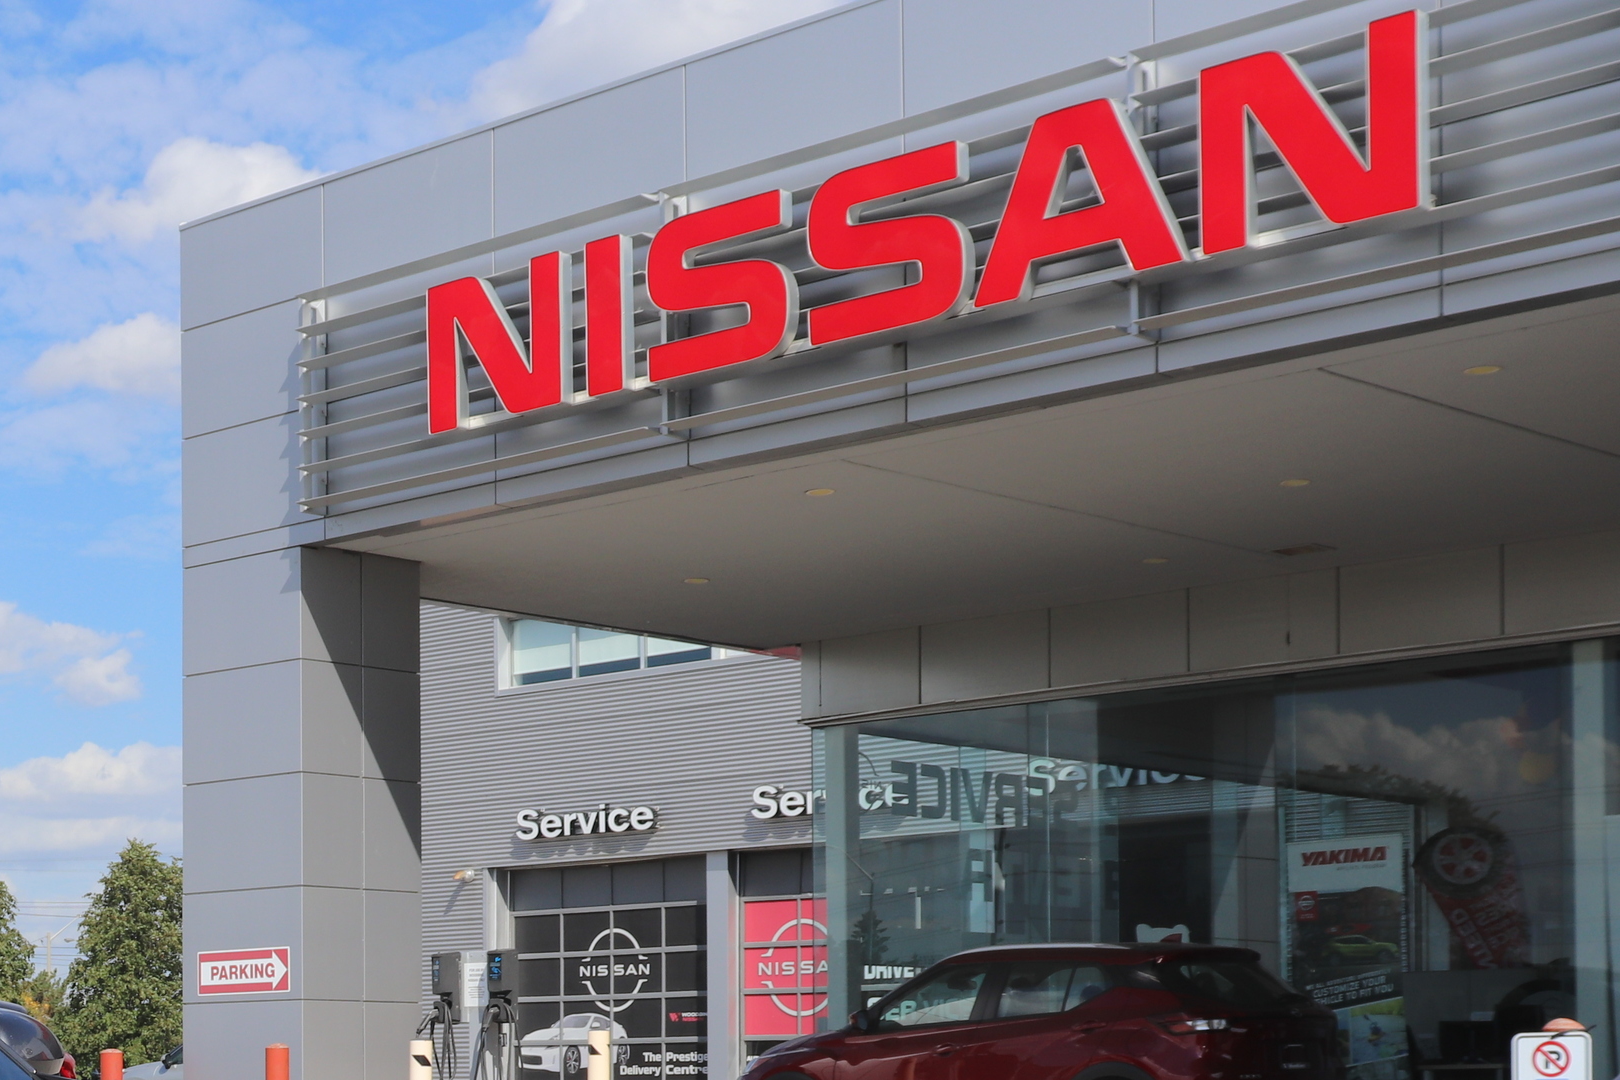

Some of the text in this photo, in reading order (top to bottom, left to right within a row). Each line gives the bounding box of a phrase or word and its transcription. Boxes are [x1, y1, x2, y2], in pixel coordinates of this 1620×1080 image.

[426, 9, 1426, 434] NISSAN
[516, 803, 654, 840] Service
[1301, 846, 1387, 867] YAKIMA
[211, 963, 275, 981] PARKING
[579, 963, 651, 977] NISSAN
[758, 960, 828, 976] NISSA
[1313, 976, 1387, 998] CUSTOMIZE YOUR
[1346, 990, 1357, 1000] TO
[643, 1052, 662, 1062] The
[620, 1064, 662, 1076] Delivery
